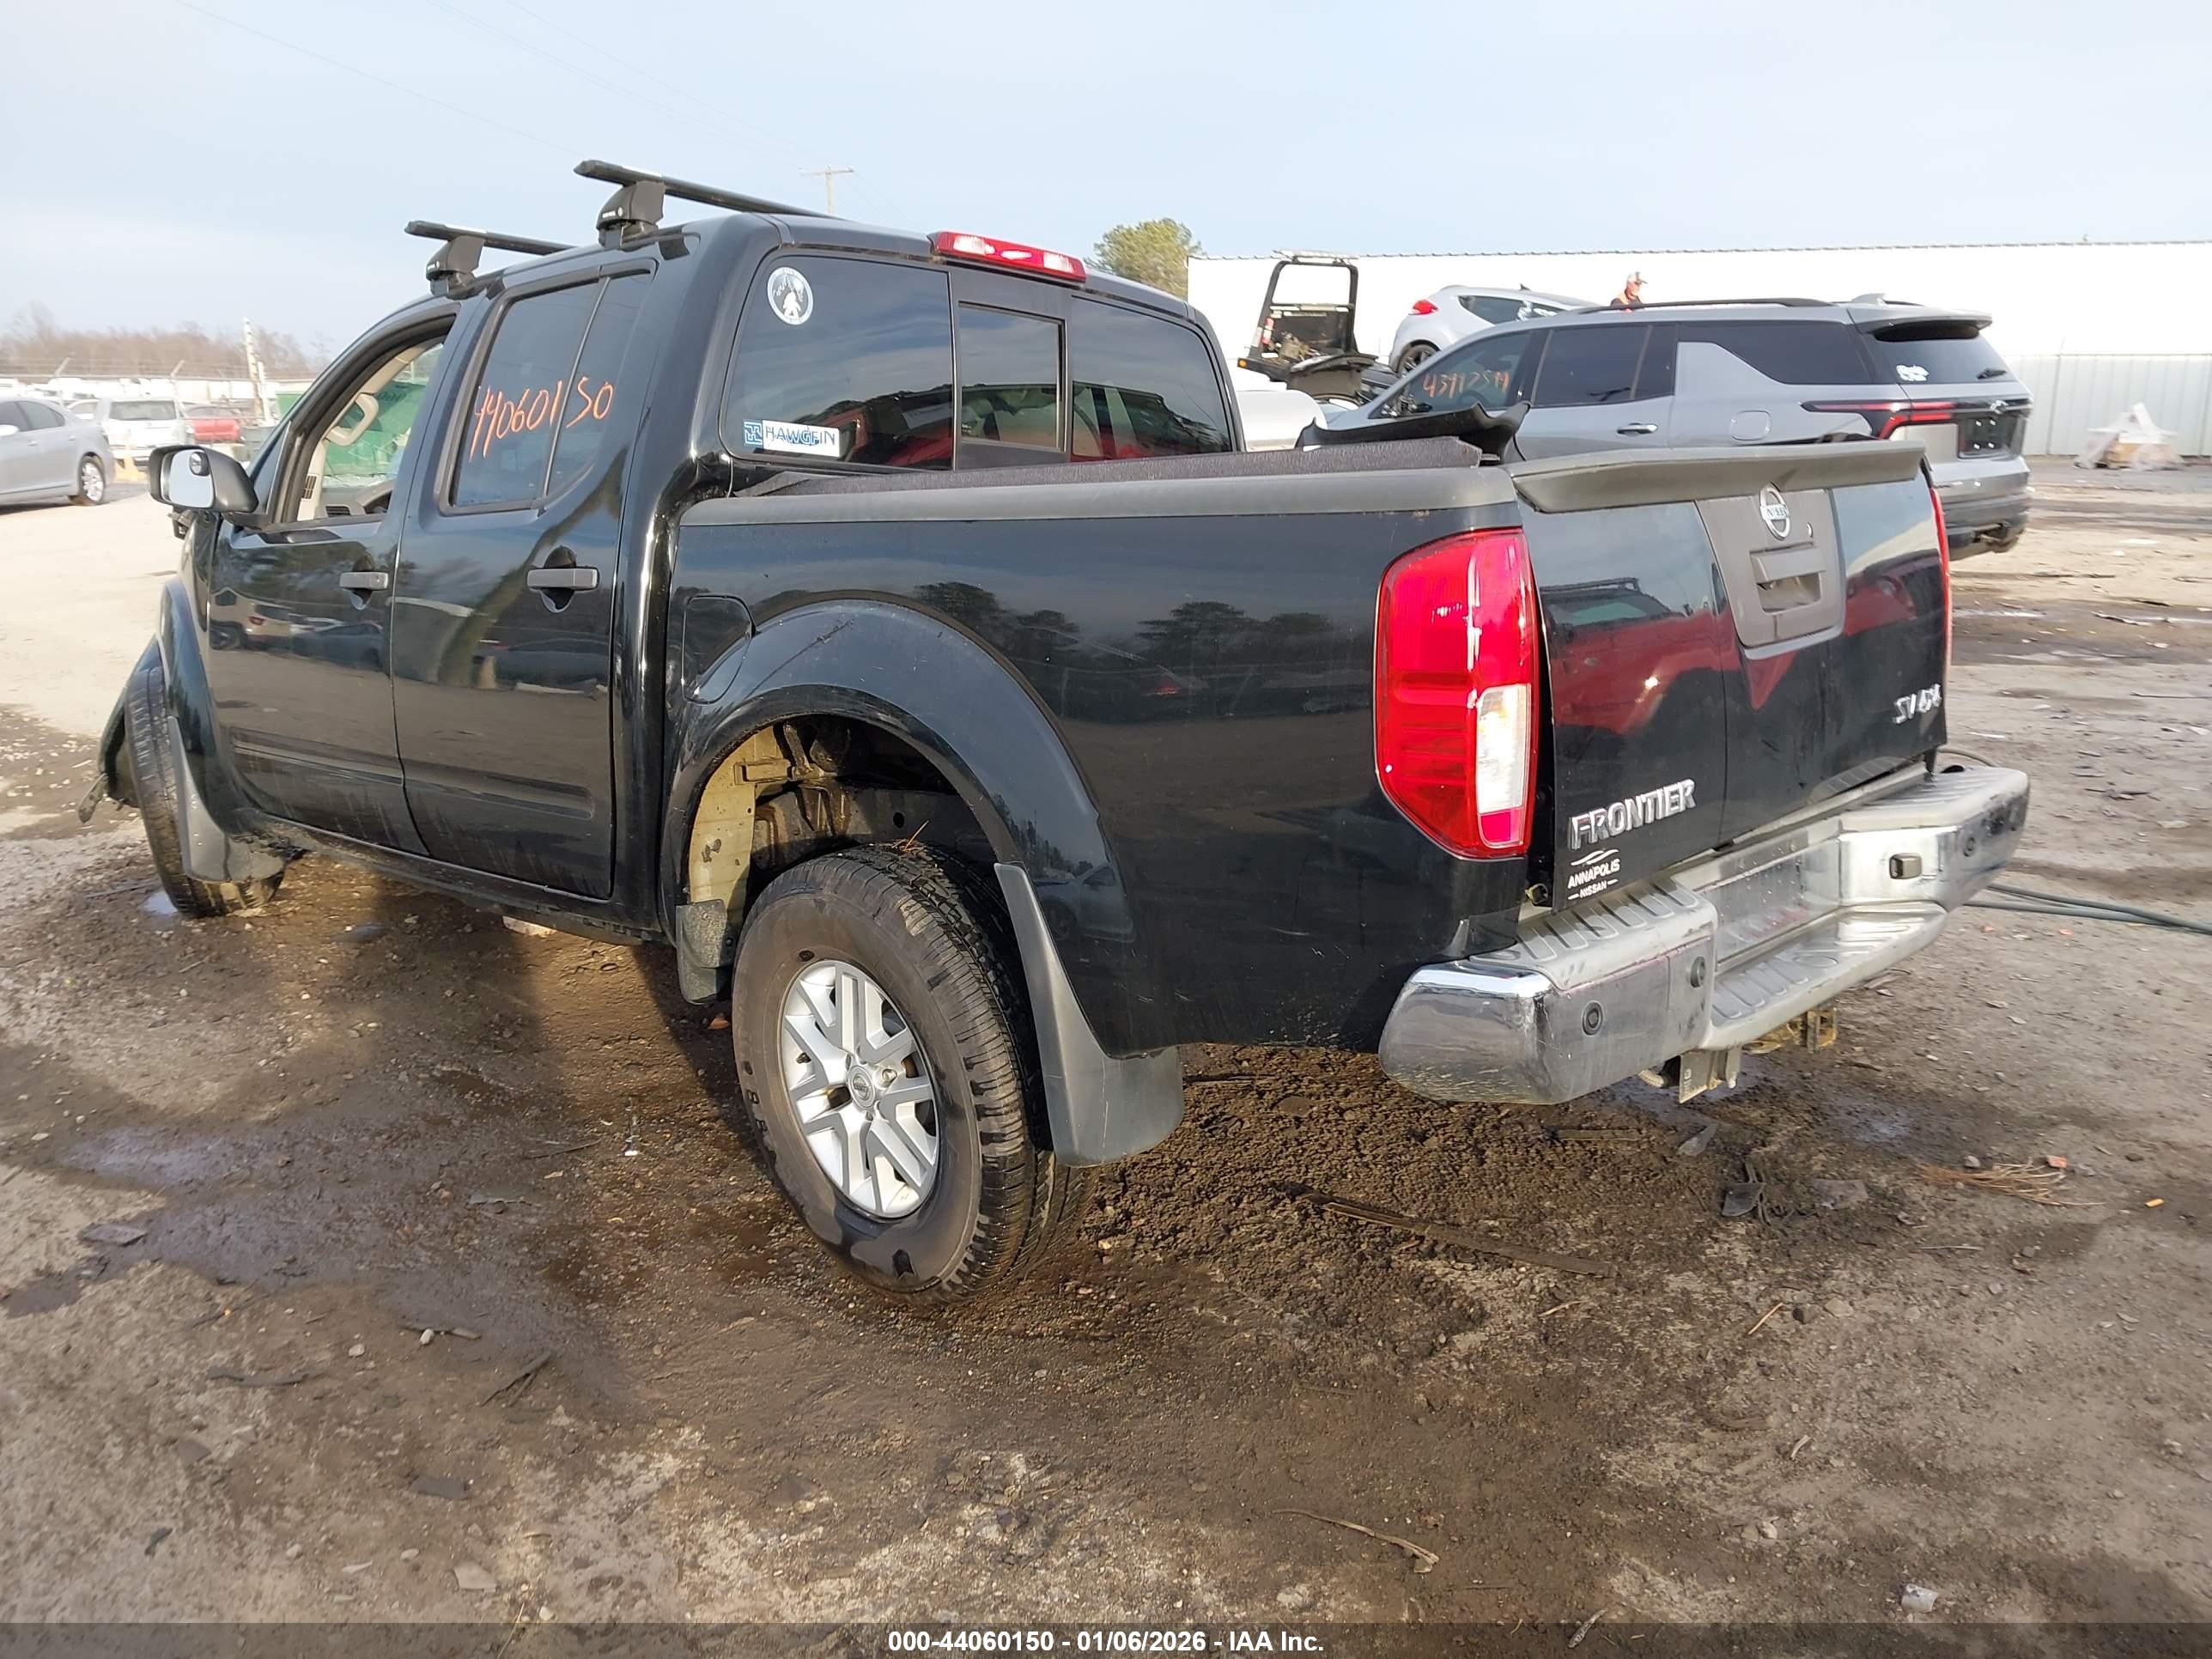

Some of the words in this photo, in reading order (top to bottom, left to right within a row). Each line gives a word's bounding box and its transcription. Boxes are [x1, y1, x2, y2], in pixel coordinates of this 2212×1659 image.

[468, 376, 614, 463] 44060150
[1892, 693, 1917, 724] SV
[1567, 777, 1697, 850] FRONTIER
[1567, 858, 1621, 890] ANNAPOLIS
[1578, 879, 1608, 899] NISSAN
